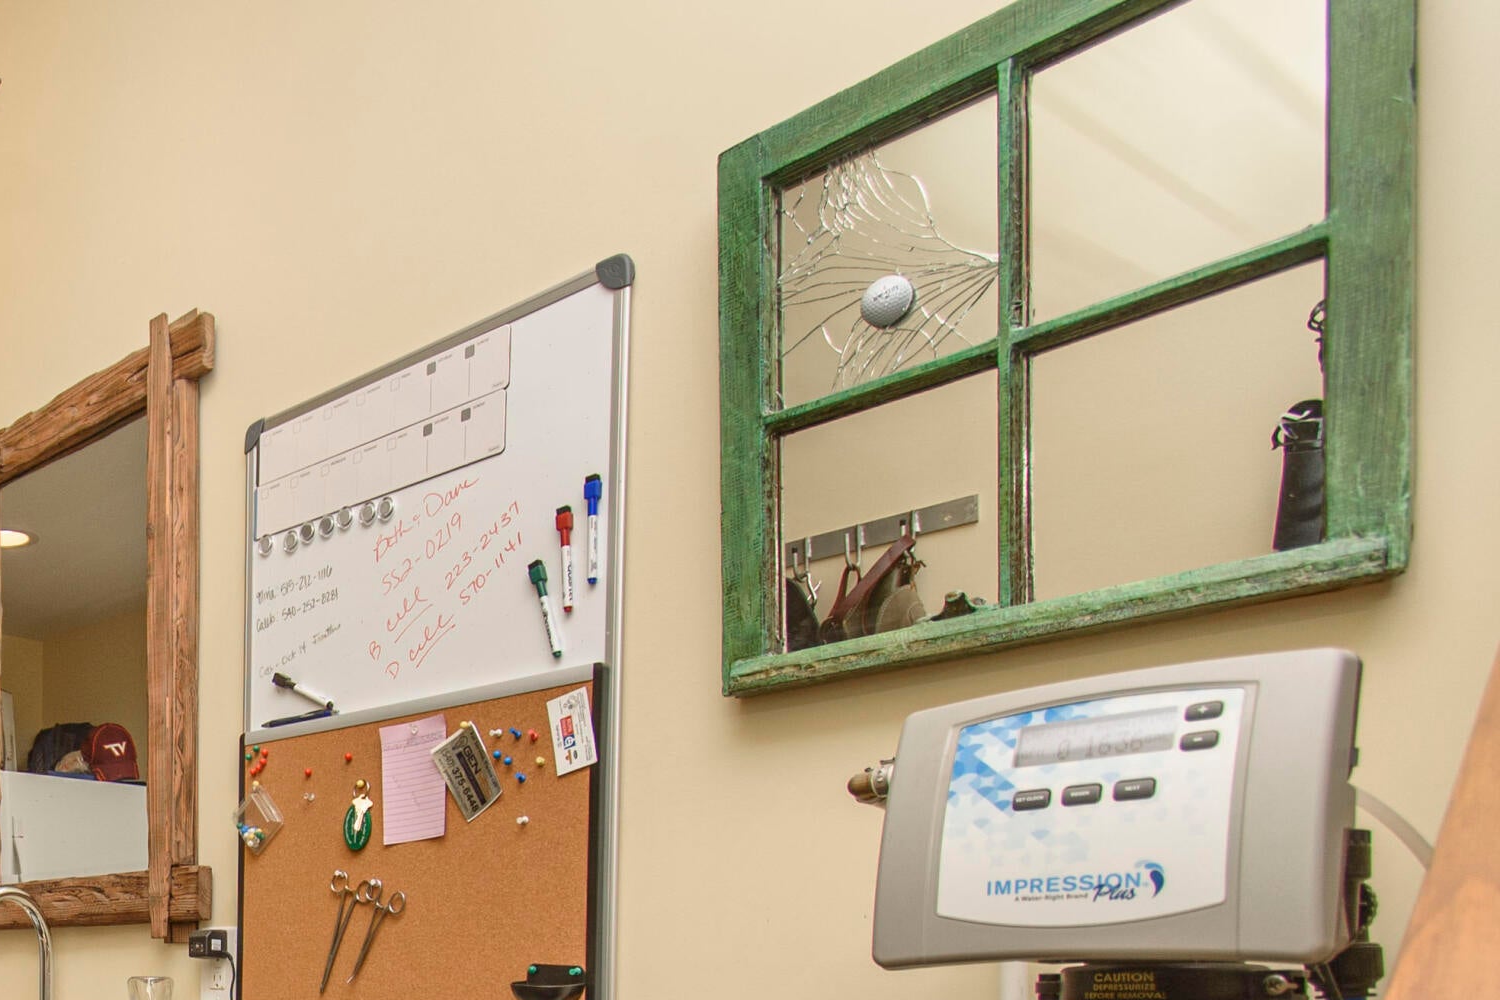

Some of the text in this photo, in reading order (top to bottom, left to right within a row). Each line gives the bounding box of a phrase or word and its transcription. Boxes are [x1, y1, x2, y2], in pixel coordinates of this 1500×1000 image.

[373, 519, 412, 563] Beth
[445, 501, 520, 590] 223-2437
[987, 872, 1141, 896] IMPRESSION
[1093, 883, 1136, 902] Plus
[1094, 972, 1154, 982] CAUTION
